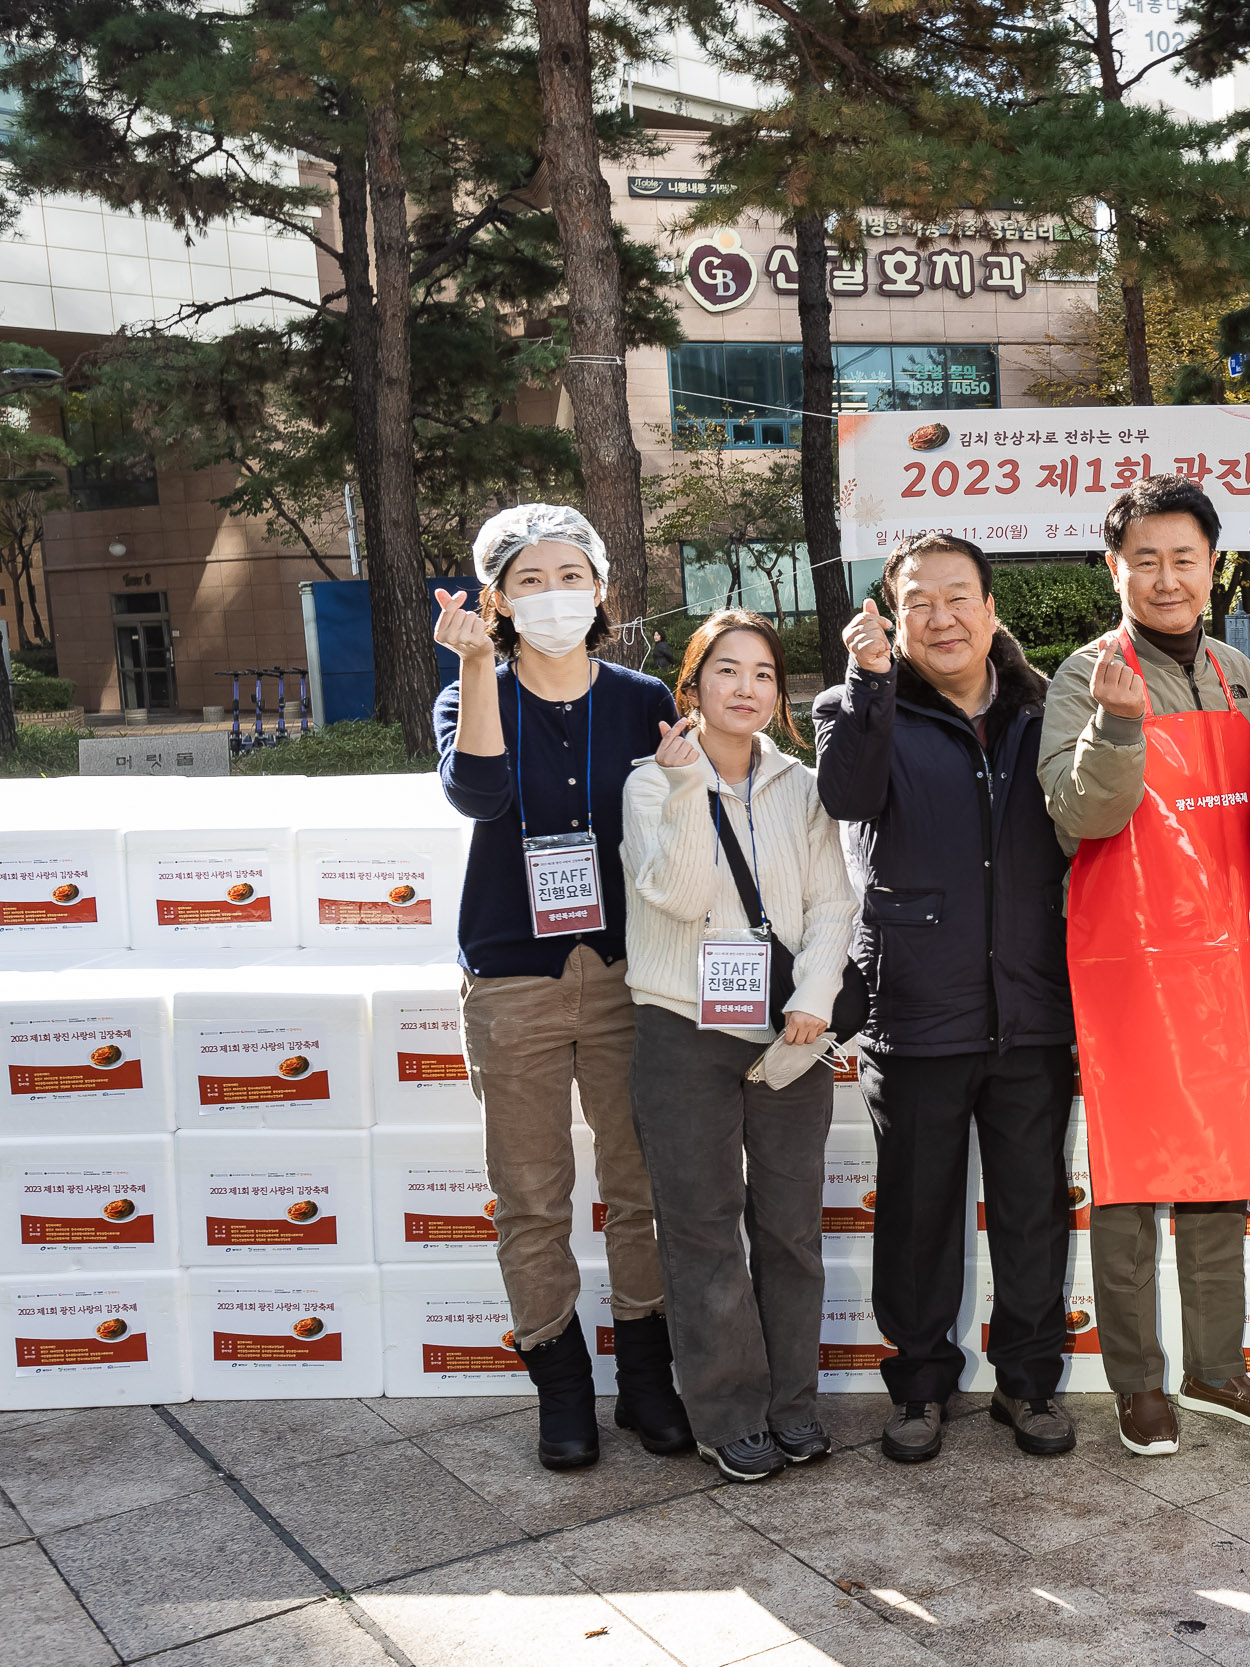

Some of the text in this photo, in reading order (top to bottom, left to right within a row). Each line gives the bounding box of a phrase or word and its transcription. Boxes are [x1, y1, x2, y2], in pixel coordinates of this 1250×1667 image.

[952, 381, 990, 395] 4650
[959, 428, 1150, 447] 김치 한상자로 전하는 안부
[900, 458, 1021, 498] 2023
[1035, 453, 1151, 497] 제1회
[116, 752, 194, 770] 머릿돌
[1176, 792, 1249, 811] 광진 사랑의 김장축제
[20, 870, 88, 880] 광진 사랑의 김장축제
[175, 872, 193, 880] 제1회
[195, 871, 209, 880] 광진
[211, 870, 232, 879] 사랑의
[234, 870, 262, 878] 김장축제
[338, 872, 355, 880] 제1회
[358, 872, 372, 880] 광진
[373, 872, 394, 880] 사랑의
[397, 872, 424, 880] 김장축제
[539, 868, 588, 886] STAFF
[538, 883, 592, 902] 진행요원
[711, 962, 760, 975] STAFF
[708, 978, 761, 991] 진행요원
[419, 1022, 438, 1030] 제1회
[441, 1021, 456, 1030] 광진
[30, 1033, 50, 1042] 제1회
[53, 1032, 69, 1042] 광진
[71, 1031, 96, 1040] 사랑의
[99, 1029, 131, 1039] 김장축제
[220, 1044, 240, 1053] 제1회
[242, 1043, 258, 1052] 광진
[260, 1042, 284, 1051] 사랑의
[287, 1040, 319, 1050] 김장축제
[44, 1185, 64, 1193] 제1회
[67, 1185, 84, 1194] 광진
[85, 1185, 110, 1194] 사랑의
[113, 1184, 145, 1193] 김장축제
[229, 1187, 249, 1195] 제1회
[252, 1186, 267, 1196] 광진
[269, 1186, 294, 1195] 사랑의
[297, 1186, 328, 1195] 김장축제
[37, 1307, 57, 1316] 제1회
[60, 1306, 76, 1315] 광진
[78, 1305, 102, 1314] 사랑의
[105, 1303, 137, 1313] 김장축제
[236, 1303, 256, 1311] 제1회
[258, 1303, 274, 1311] 광진
[276, 1303, 300, 1312] 사랑의
[303, 1303, 334, 1312] 김장축제
